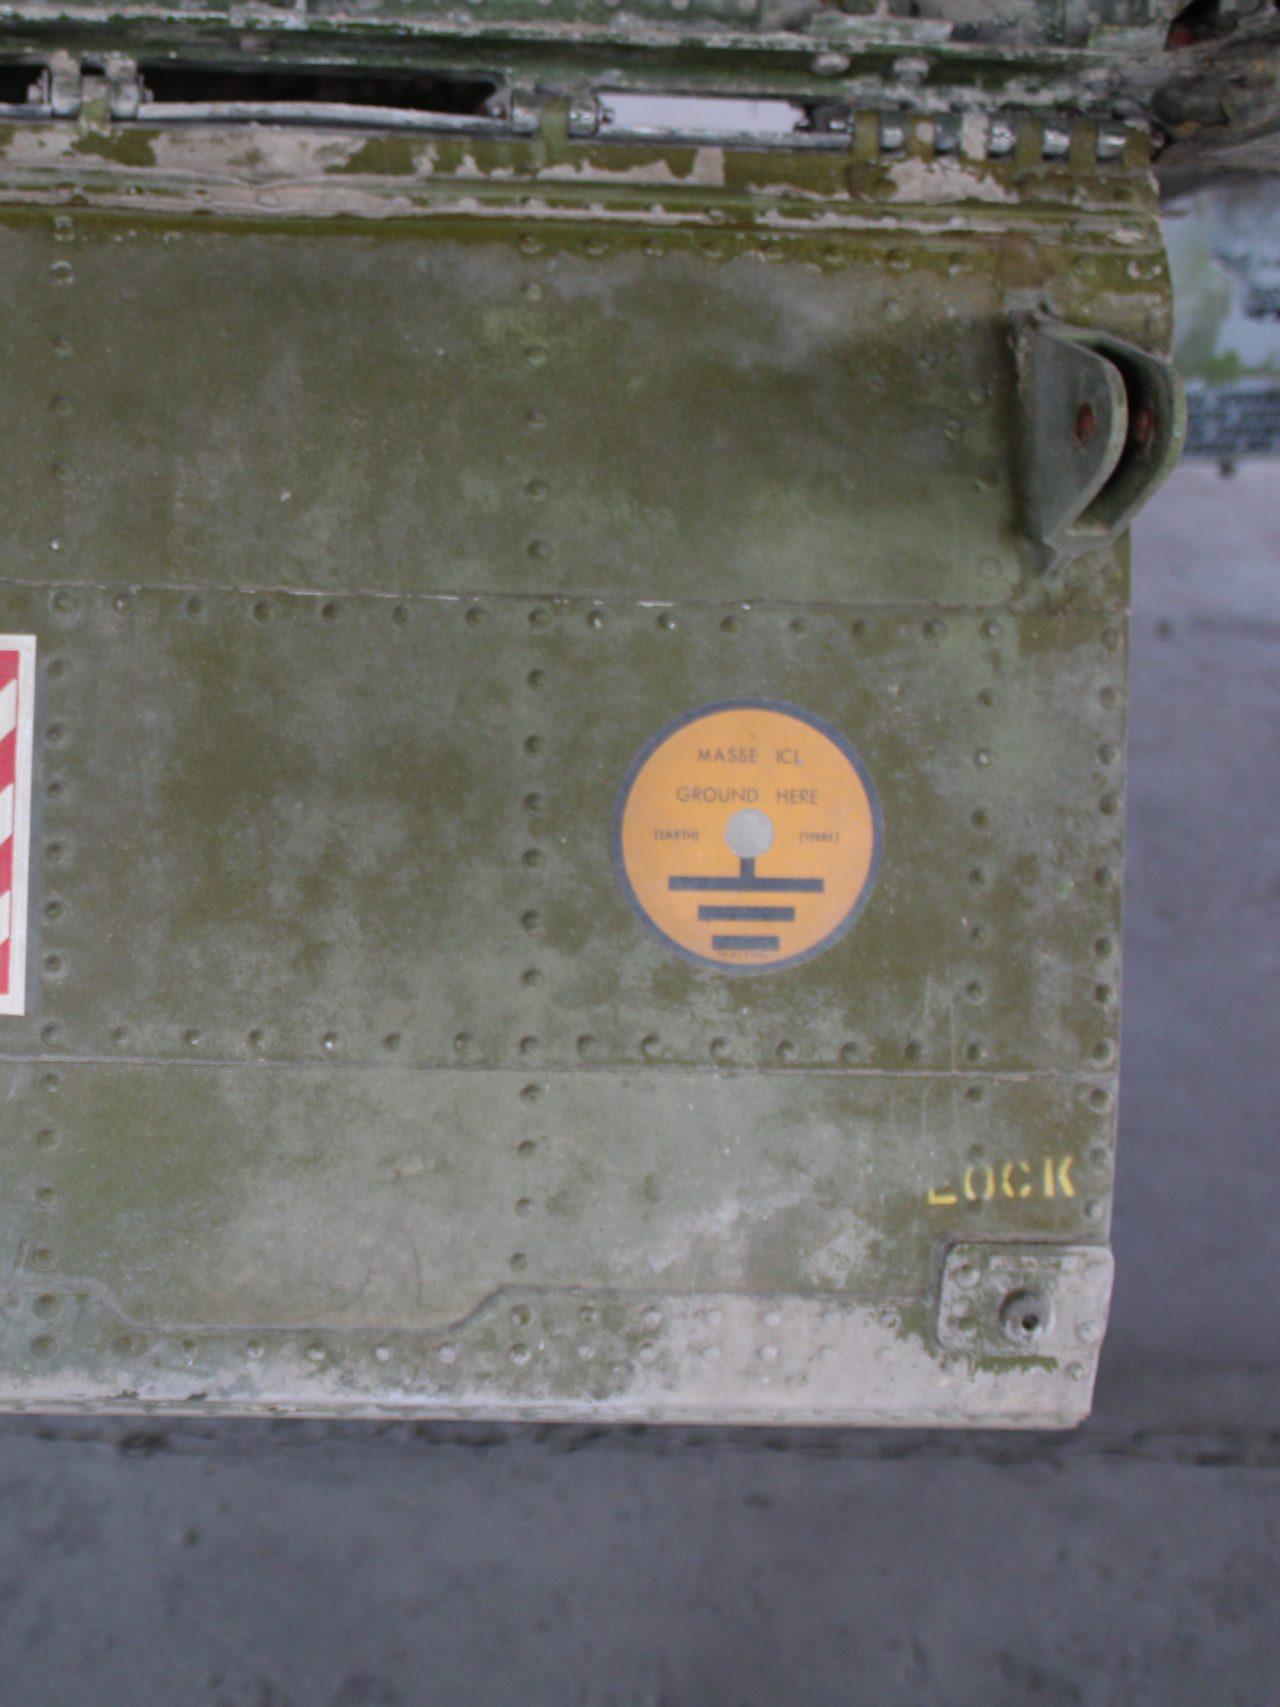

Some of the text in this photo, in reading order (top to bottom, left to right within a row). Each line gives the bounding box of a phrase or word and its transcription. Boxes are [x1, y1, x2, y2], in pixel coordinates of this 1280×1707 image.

[697, 747, 760, 764] MASSE
[676, 785, 820, 806] GROUND HERE
